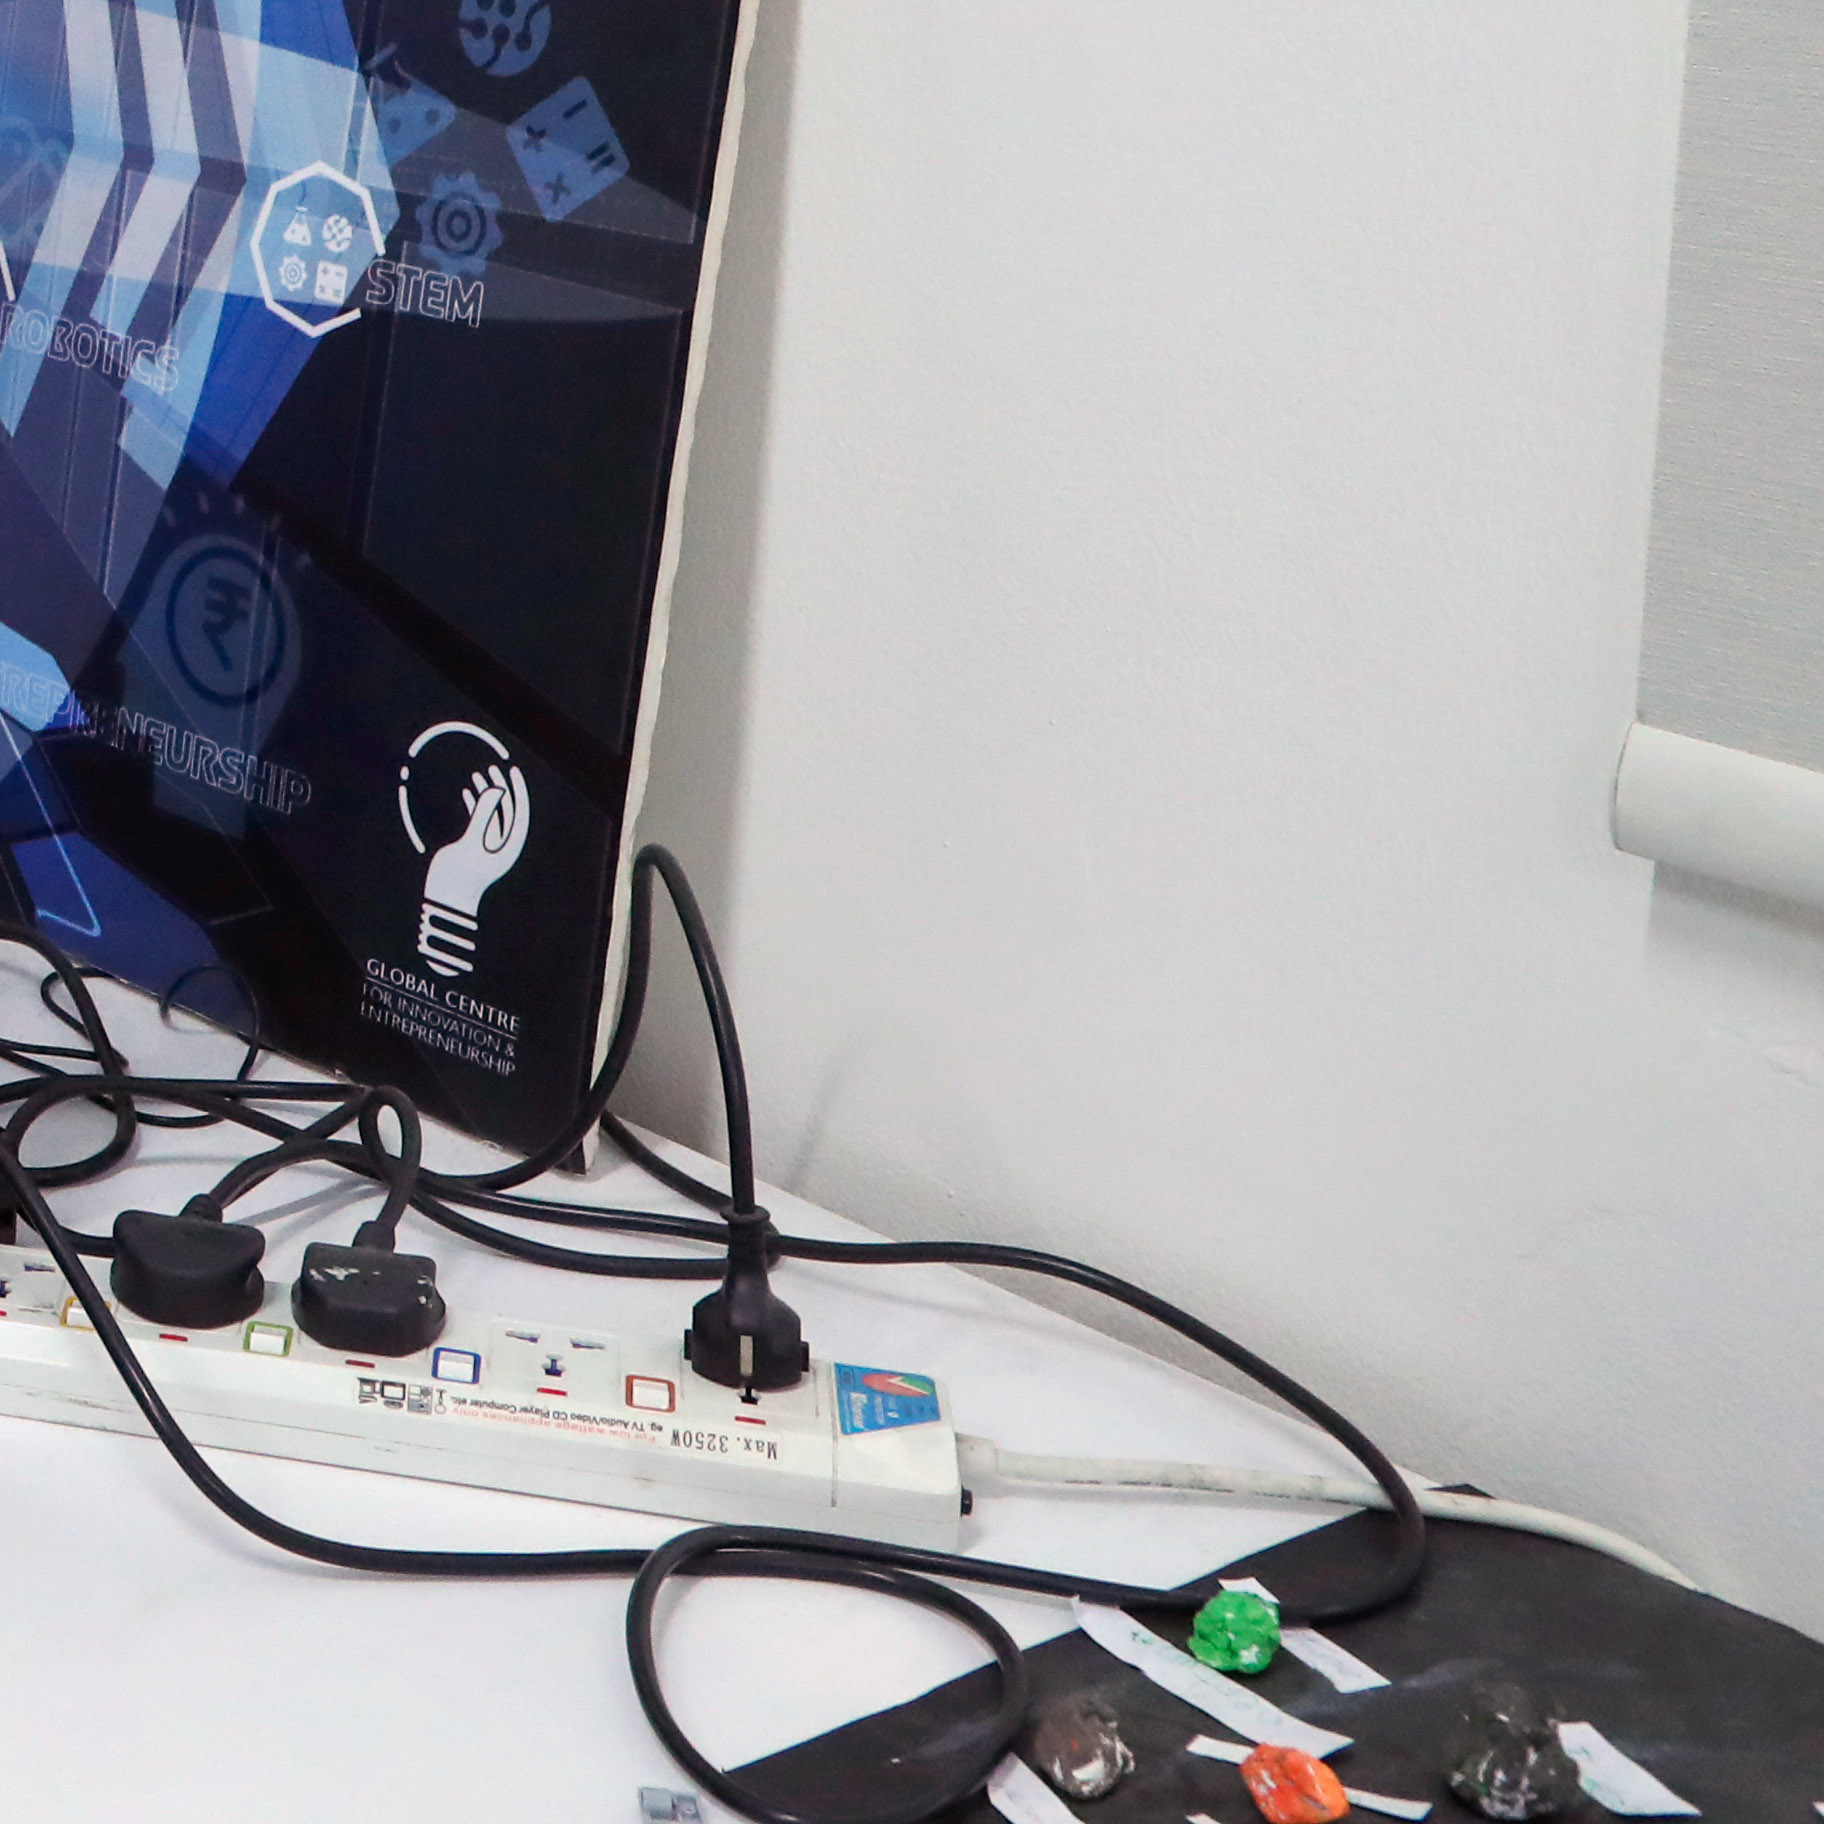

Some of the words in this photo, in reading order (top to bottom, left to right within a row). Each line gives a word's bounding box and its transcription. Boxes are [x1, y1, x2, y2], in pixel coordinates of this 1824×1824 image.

[366, 259, 484, 328] STEM
[366, 958, 439, 1001] GLOBAL
[445, 989, 521, 1033] CENTRE
[397, 993, 501, 1052] INNOVATION
[504, 1042, 516, 1058] &
[469, 1398, 518, 1415] Computer
[519, 1405, 551, 1419] Player
[552, 1410, 569, 1421] CD
[569, 1411, 630, 1430] Audio/Video
[631, 1418, 645, 1432] TV
[670, 1428, 729, 1454] 3250W
[736, 1436, 778, 1460] Max.
